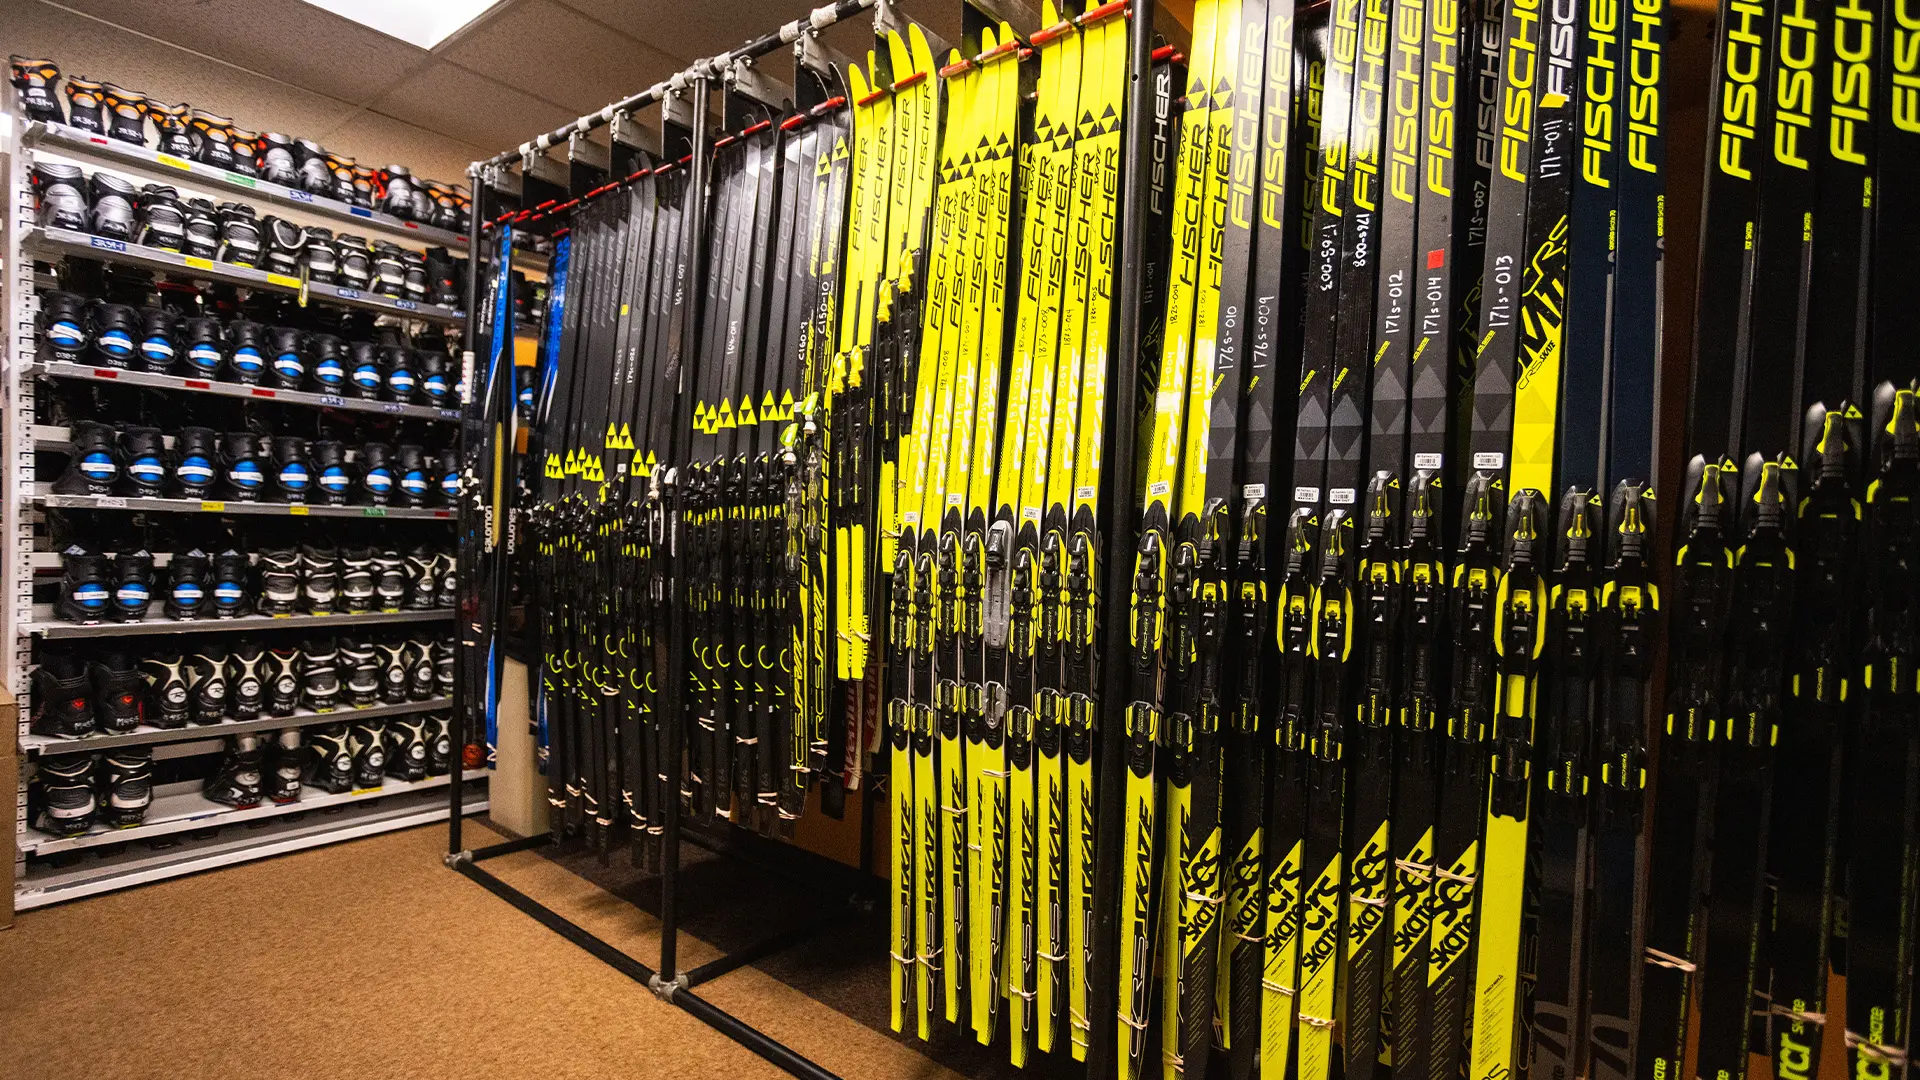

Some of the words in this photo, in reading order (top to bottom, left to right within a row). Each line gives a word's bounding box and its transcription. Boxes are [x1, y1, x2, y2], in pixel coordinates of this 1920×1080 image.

[896, 99, 910, 206] FISCHER
[918, 83, 930, 181] FISCHER
[1150, 74, 1170, 215] FISCHER
[1231, 22, 1266, 229] FISCHER
[1262, 15, 1294, 229] FISCHER
[810, 181, 826, 278] FISCHER
[826, 166, 844, 264] FISCHER
[852, 138, 868, 251] FISCHER
[870, 127, 887, 242] FISCHER
[992, 172, 1010, 312] FISCHER
[1027, 156, 1051, 302] FISCHER
[1048, 164, 1069, 312] FISCHER
[1073, 153, 1094, 303] FISCHER
[1098, 147, 1116, 300] FISCHER
[1180, 124, 1206, 286] FISCHER
[930, 196, 952, 330] FISCHER
[950, 192, 970, 328] FISCHER
[970, 174, 990, 312] FISCHER
[1489, 255, 1513, 327] 171s-013
[818, 282, 829, 334] C150-10
[1219, 306, 1237, 369] 176s-010
[1254, 296, 1274, 368] 176s-009
[1385, 270, 1404, 333] 171s-012
[1424, 277, 1441, 334] 171s-014
[1540, 341, 1556, 362] SKATE
[484, 506, 493, 553] salomon
[507, 508, 516, 554] salomon
[991, 780, 1004, 896] SKATE
[1022, 798, 1032, 918] SKATE
[1049, 774, 1061, 898] SKATE
[1135, 795, 1152, 928] SKATE
